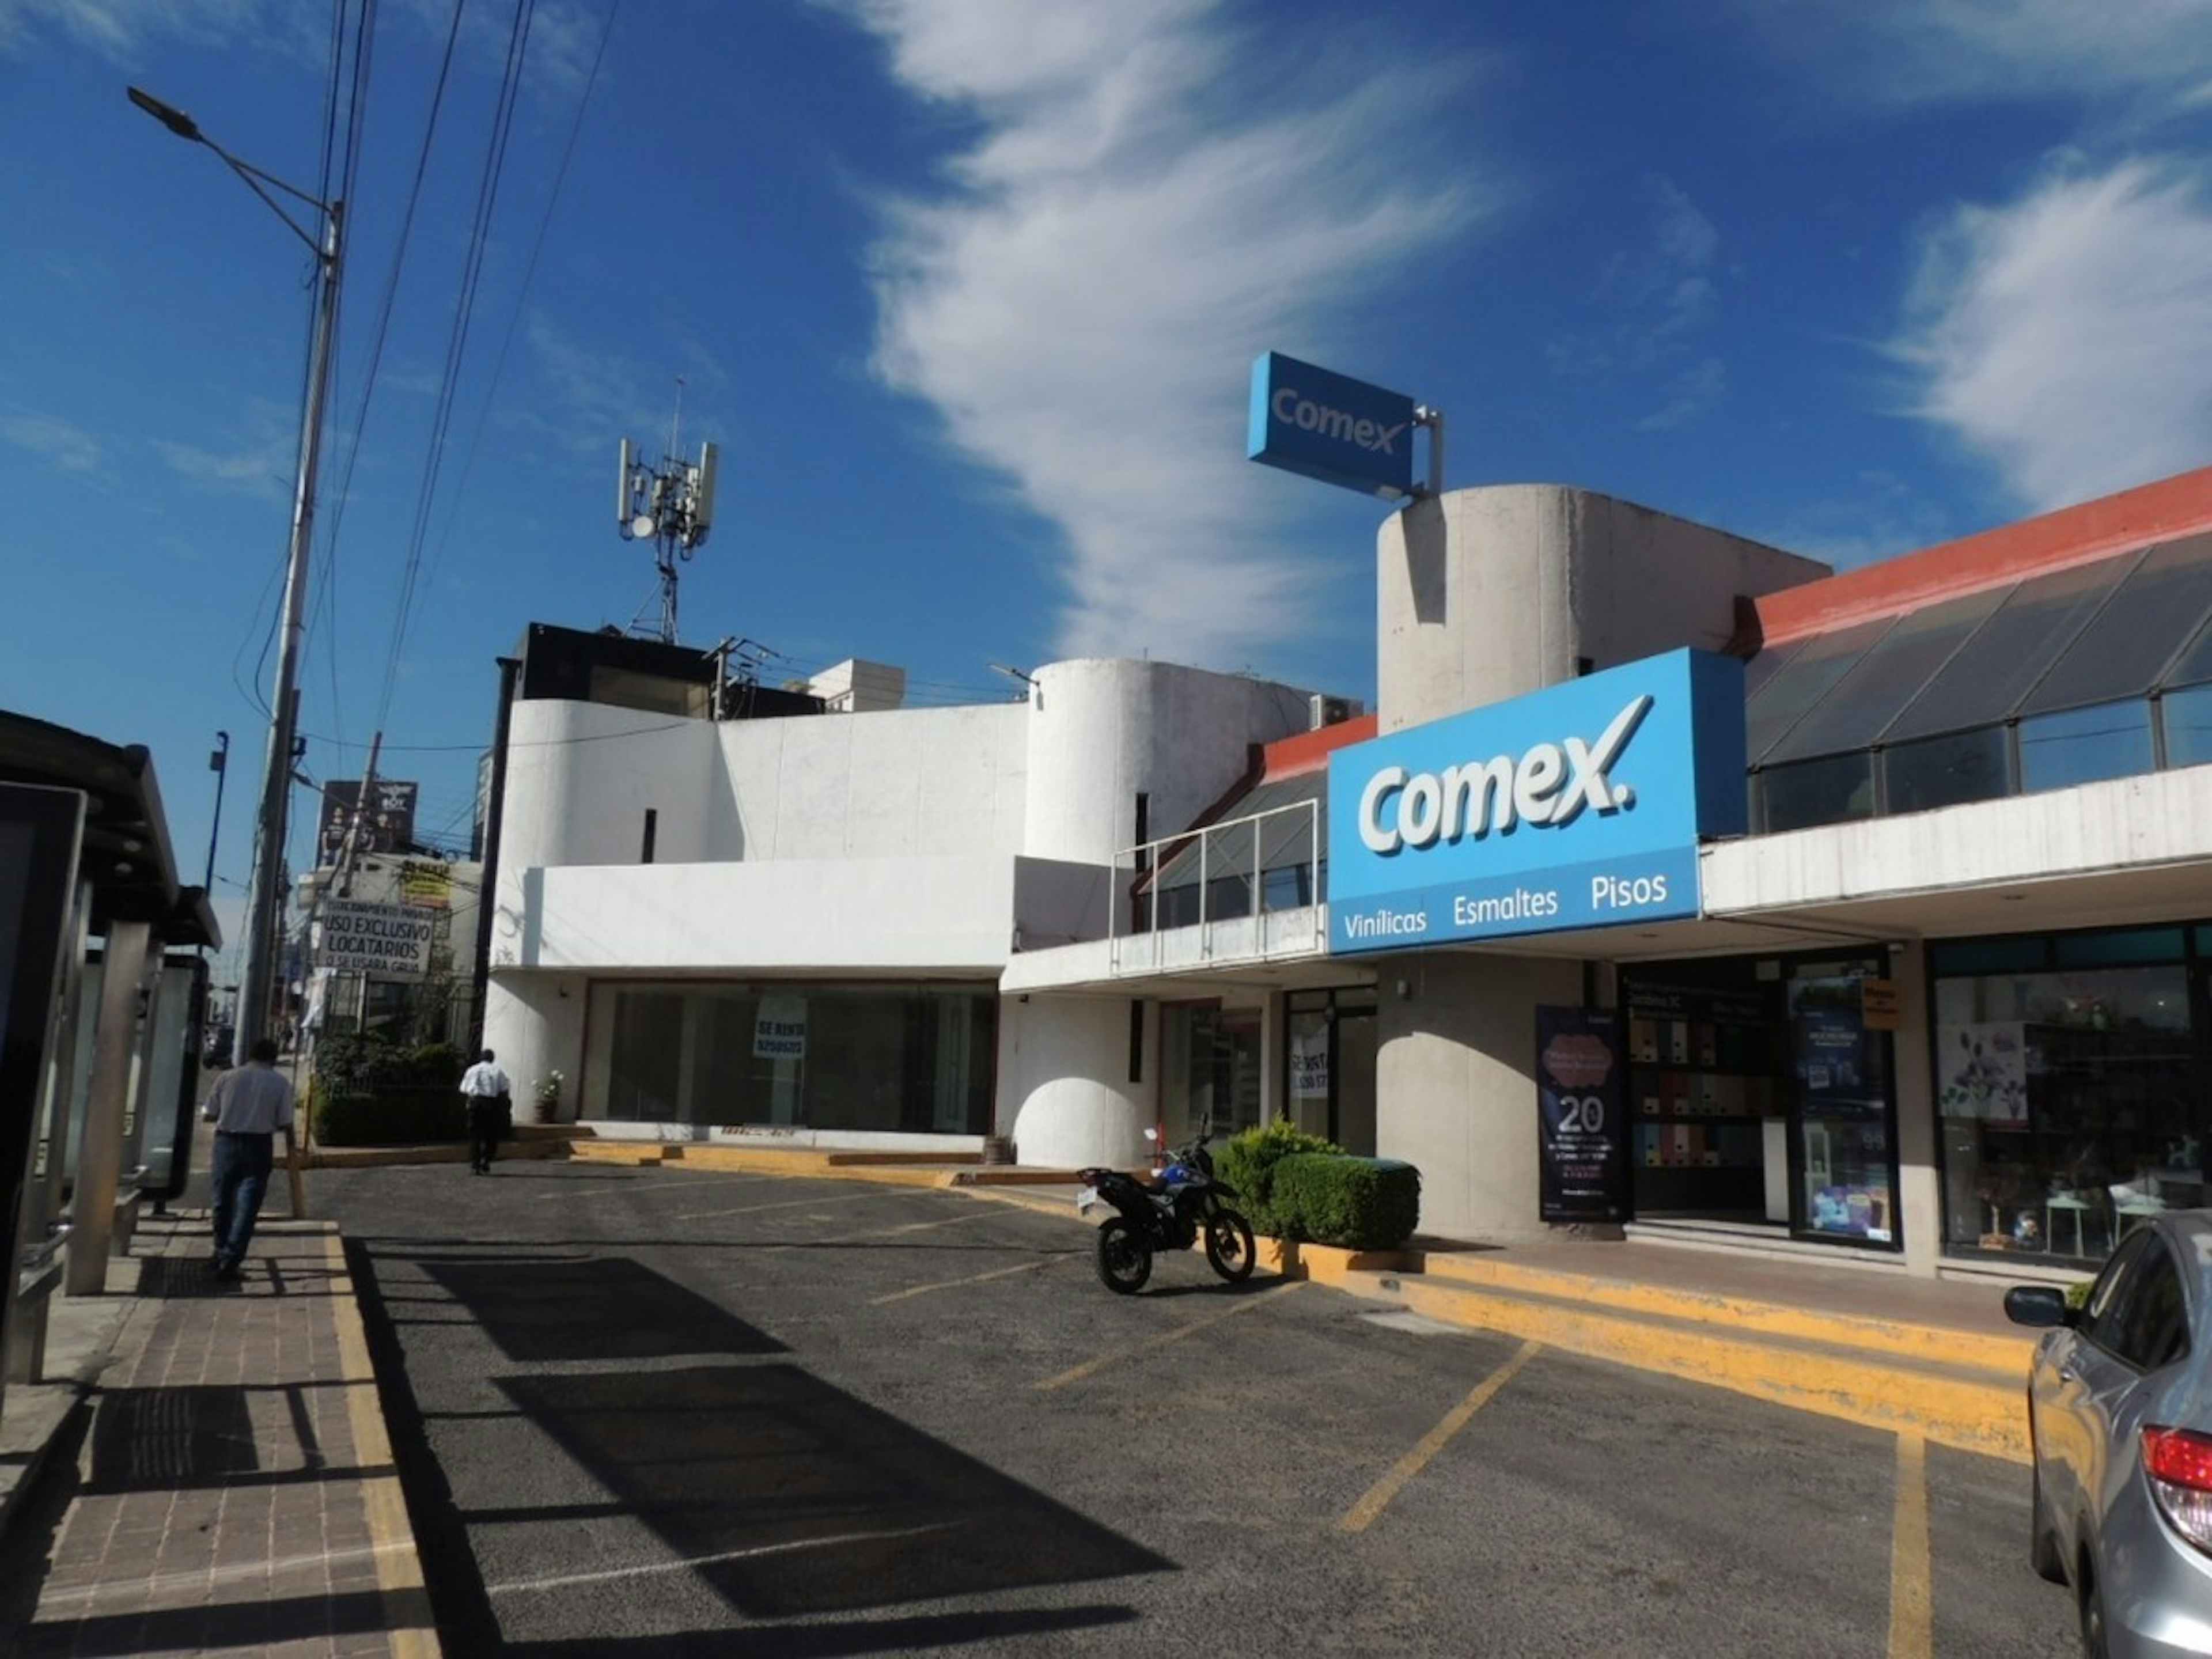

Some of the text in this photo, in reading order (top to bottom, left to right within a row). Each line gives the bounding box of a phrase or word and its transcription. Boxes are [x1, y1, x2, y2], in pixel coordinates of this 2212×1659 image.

[1271, 387, 1408, 454] Comex
[1345, 875, 1668, 938] Vinílicas Esmaltes Pisos
[324, 914, 430, 941] USO EXCLUSIVO
[328, 934, 420, 960] LOCATARIOS
[1559, 1096, 1604, 1133] 20
